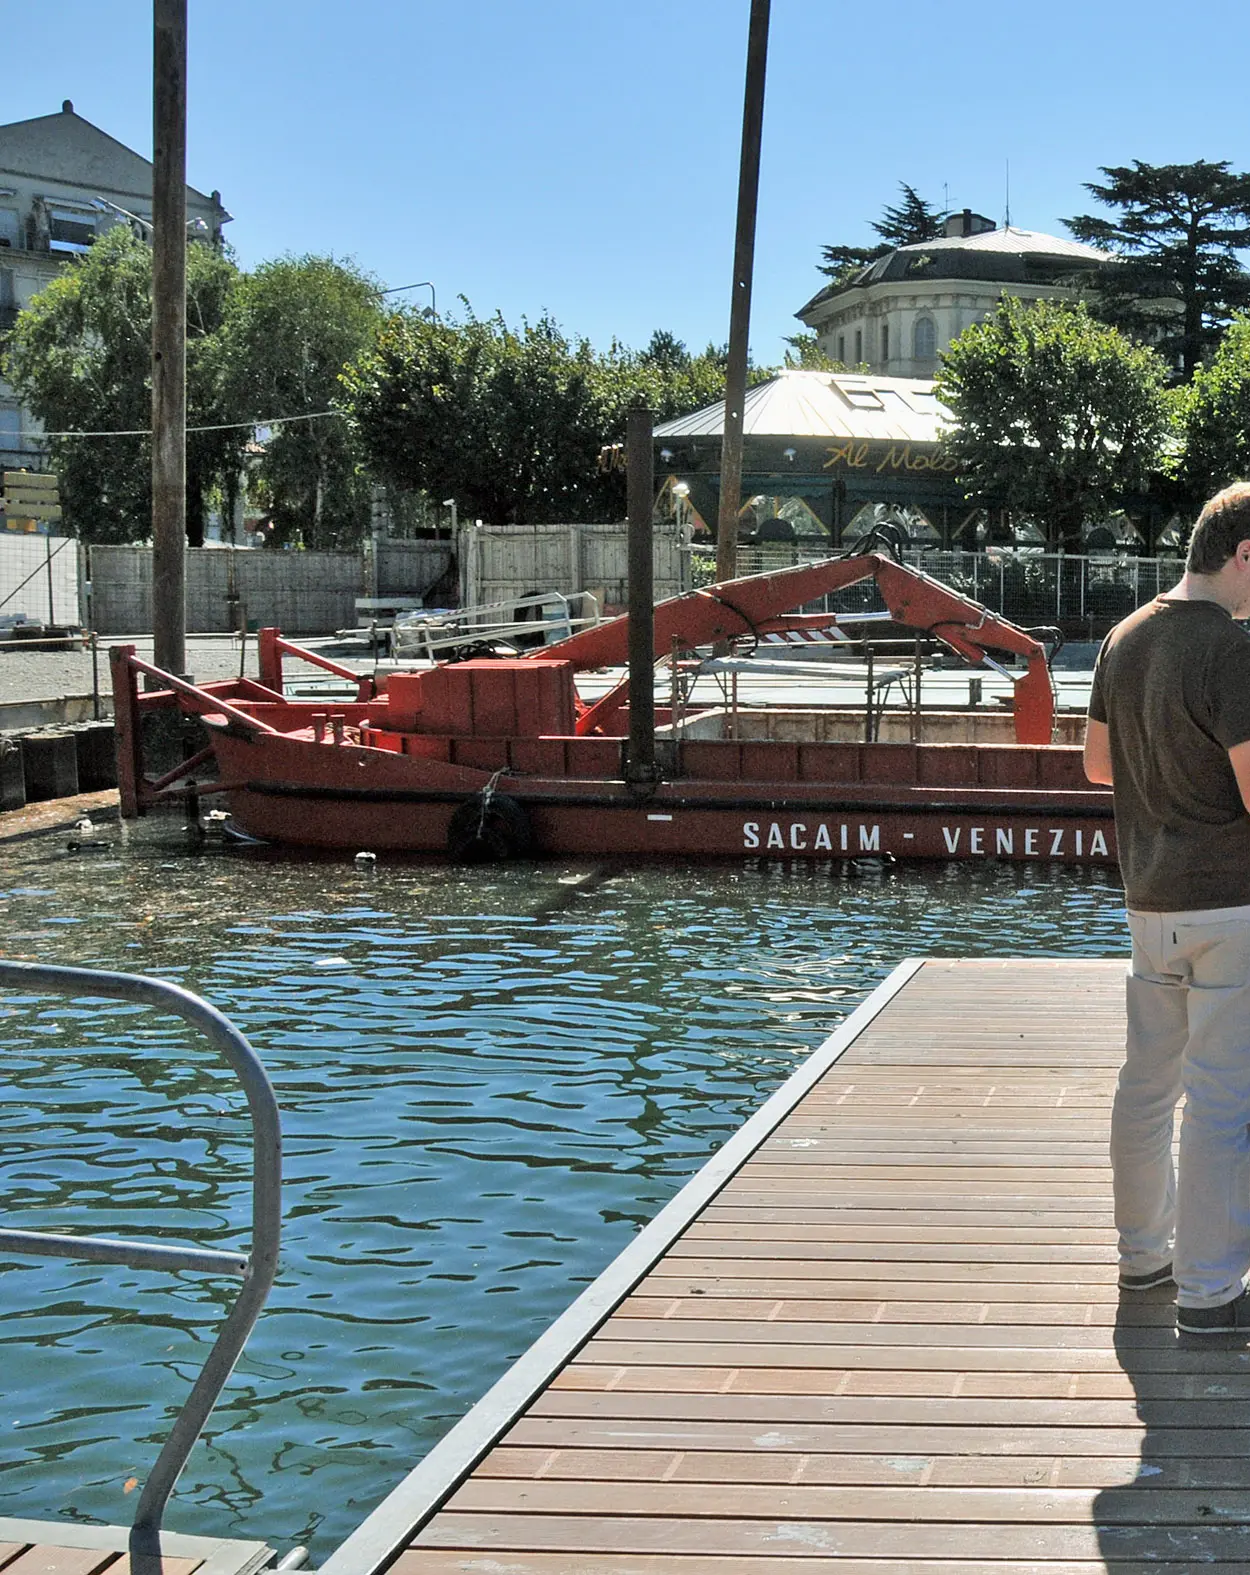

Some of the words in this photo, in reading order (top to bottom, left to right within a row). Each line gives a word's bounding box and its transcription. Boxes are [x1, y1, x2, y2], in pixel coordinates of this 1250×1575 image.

[823, 440, 869, 468] Al
[876, 444, 958, 473] Molo
[743, 822, 880, 851] SACAIM
[942, 827, 1108, 856] VENEZIA
